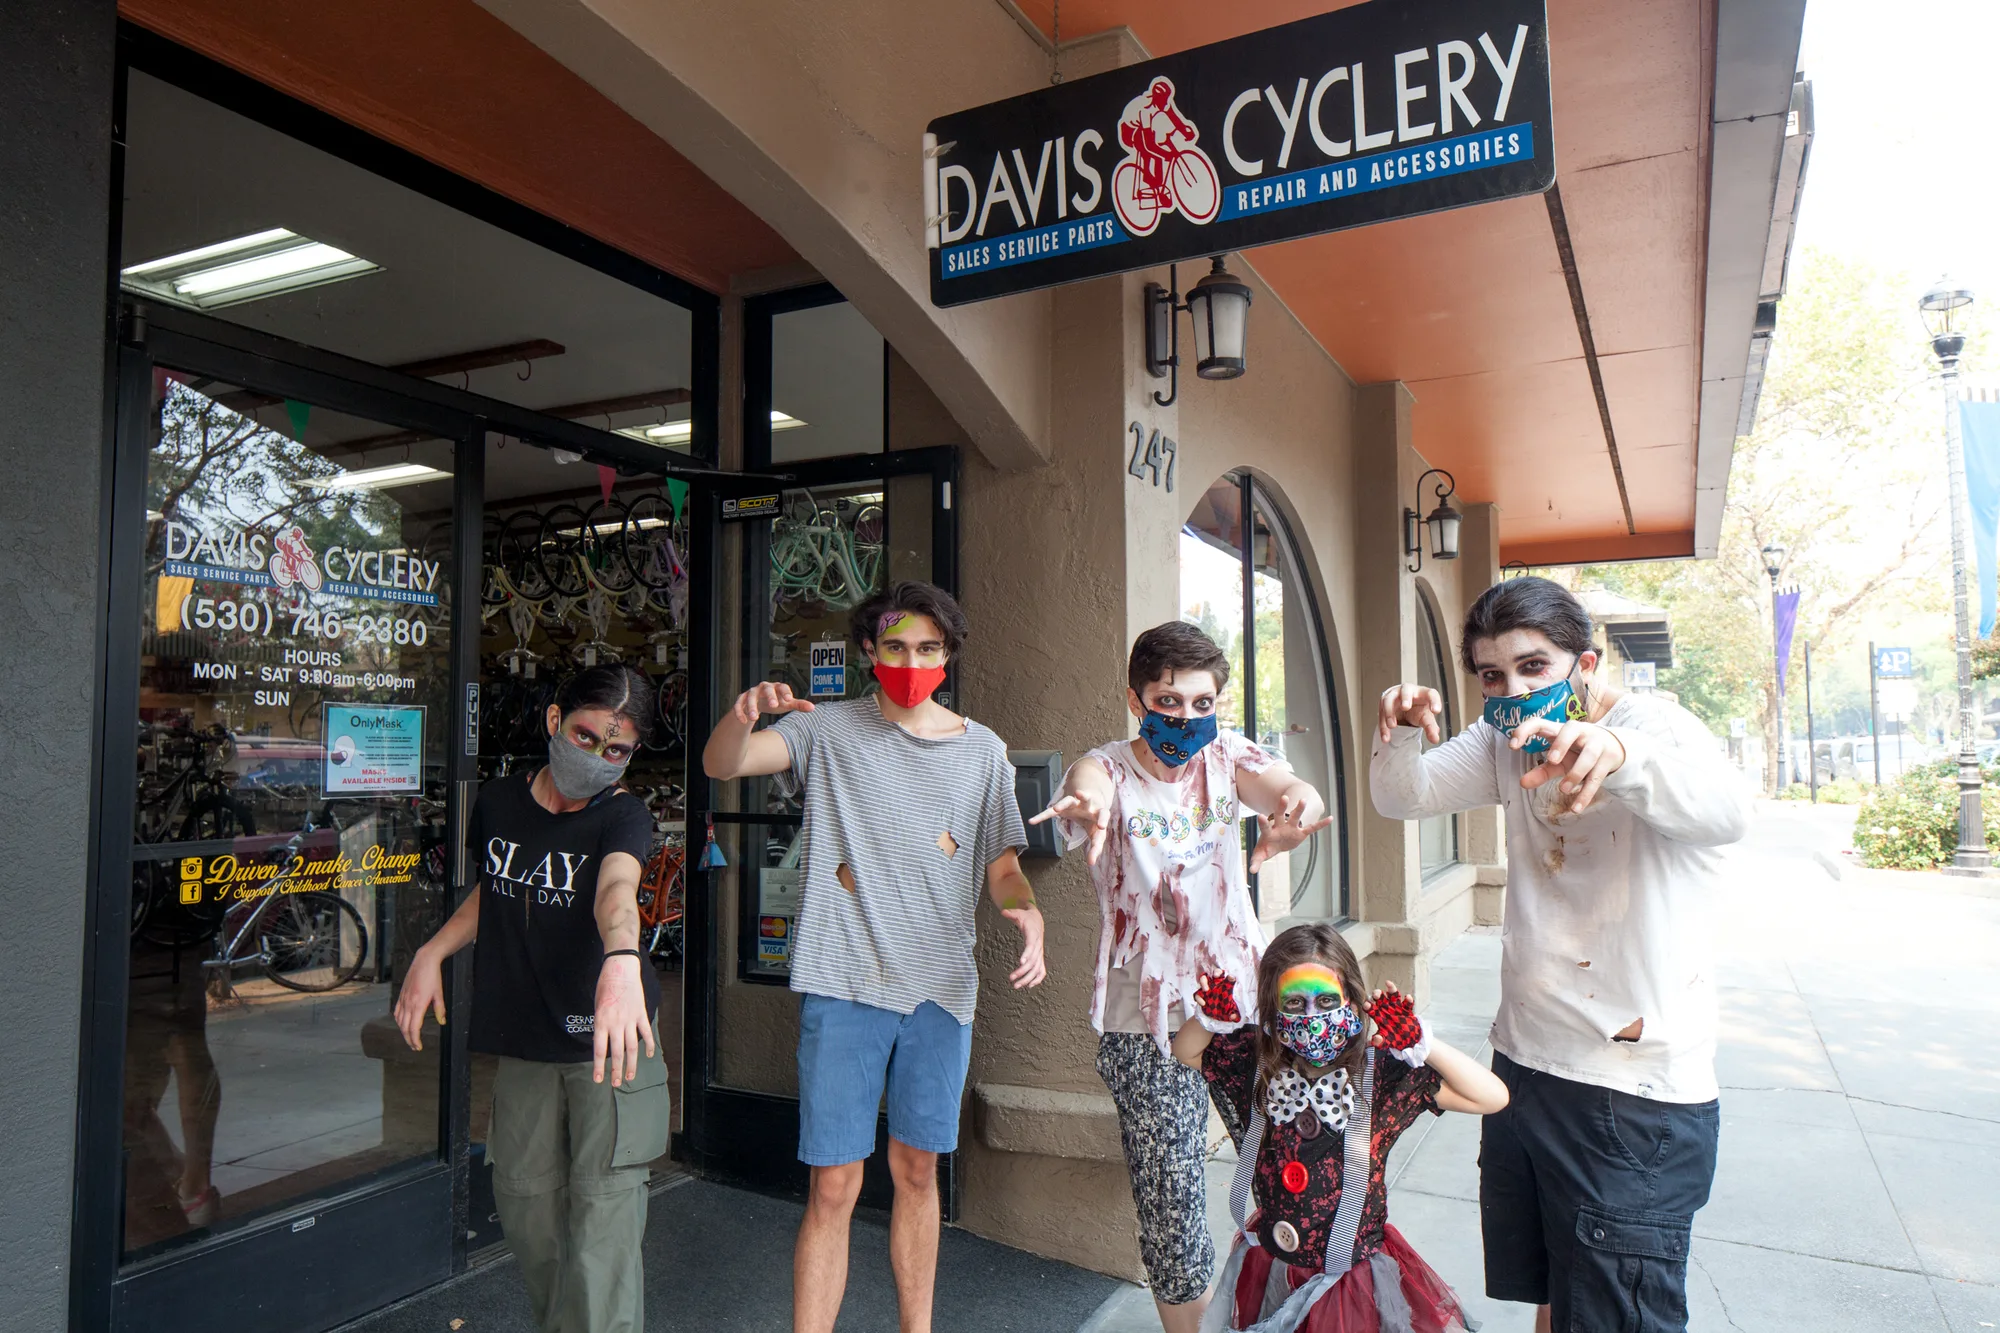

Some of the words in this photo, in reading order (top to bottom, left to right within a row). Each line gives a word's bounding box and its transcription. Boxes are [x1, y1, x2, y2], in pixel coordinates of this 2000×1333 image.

[939, 129, 1104, 244] DAVIS
[1223, 24, 1529, 176] CYCLERY
[1238, 178, 1306, 211] REPAIR
[1319, 167, 1357, 194] AND
[1370, 133, 1520, 184] ACCESSORIES
[949, 247, 990, 272] SALES
[999, 231, 1059, 261] SERVICE
[1068, 219, 1114, 246] PARTS
[1129, 421, 1177, 493] 247
[738, 497, 777, 509] SCOTT
[167, 521, 267, 571] DAVIS
[324, 546, 440, 592] CYCLERY
[170, 564, 198, 576] SALES
[203, 568, 240, 581] SERVICE
[245, 573, 270, 585] PARTS
[329, 583, 359, 595] REPAIR
[363, 587, 379, 597] AND
[382, 590, 435, 604] ACCESSORIES
[181, 594, 273, 636] (530)
[288, 607, 427, 647] 746-2380
[284, 649, 342, 667] HOURS
[812, 647, 844, 667] OPEN
[1889, 651, 1910, 672] P
[193, 662, 237, 680] MON
[260, 666, 293, 682] SAT
[813, 674, 834, 686] COME
[834, 673, 843, 685] IN
[254, 690, 290, 706] SUN
[350, 715, 403, 730] OnlyMask
[468, 689, 477, 738] PULL
[342, 777, 382, 785] AVAILABLE
[383, 776, 407, 784] INSIDE
[486, 837, 589, 893] SLAY
[233, 882, 278, 903] Support
[280, 877, 331, 894] Childhood
[333, 874, 363, 889] Cancer
[365, 871, 412, 886] Awareness
[492, 879, 516, 898] ALL
[538, 889, 575, 908] DAY
[764, 945, 783, 955] VISA
